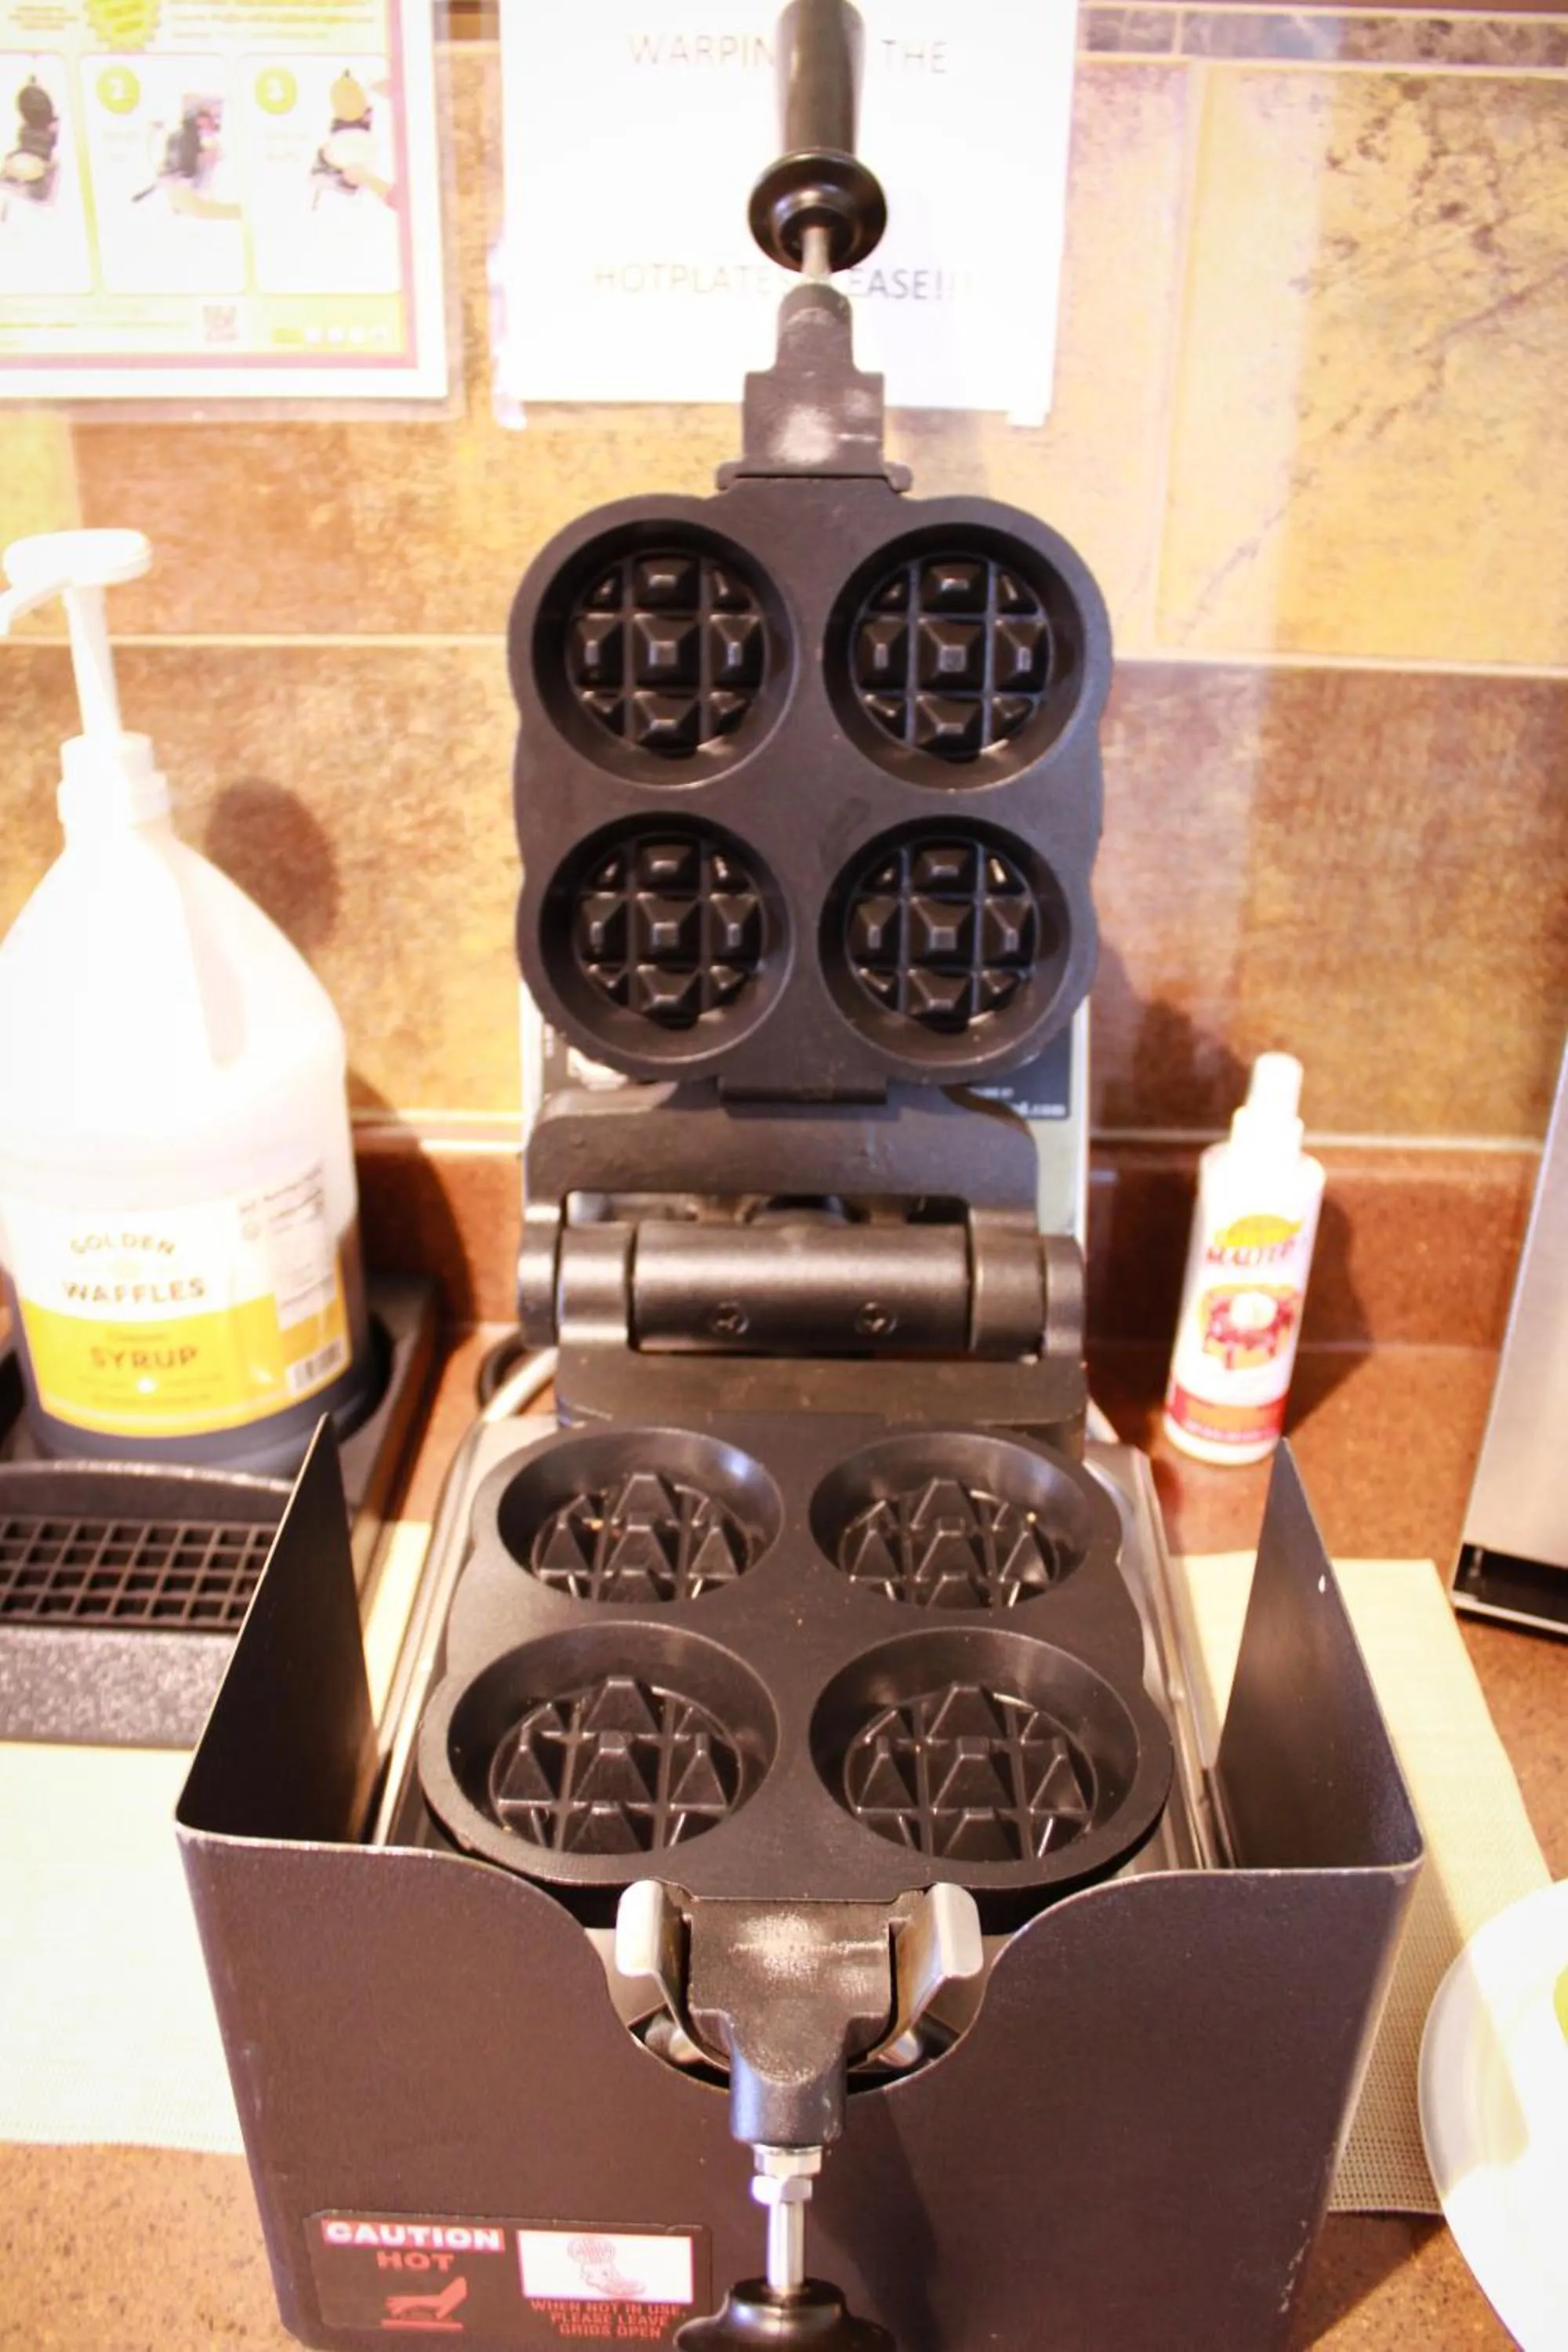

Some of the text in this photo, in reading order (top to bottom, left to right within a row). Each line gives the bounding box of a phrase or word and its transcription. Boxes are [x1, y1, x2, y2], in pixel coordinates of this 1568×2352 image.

[626, 33, 948, 74] WARPIN THE
[70, 1232, 176, 1255] GOLDEN
[62, 1276, 205, 1304] WAFFLES
[89, 1344, 199, 1370] SYRUP
[325, 2221, 500, 2251] CAUTION
[376, 2250, 455, 2273] HOT
[531, 2299, 581, 2313] WHEN
[587, 2301, 618, 2314] NOT
[551, 2312, 669, 2327] PLEASE LEAVE
[559, 2324, 662, 2339] GRIDS OPEN
